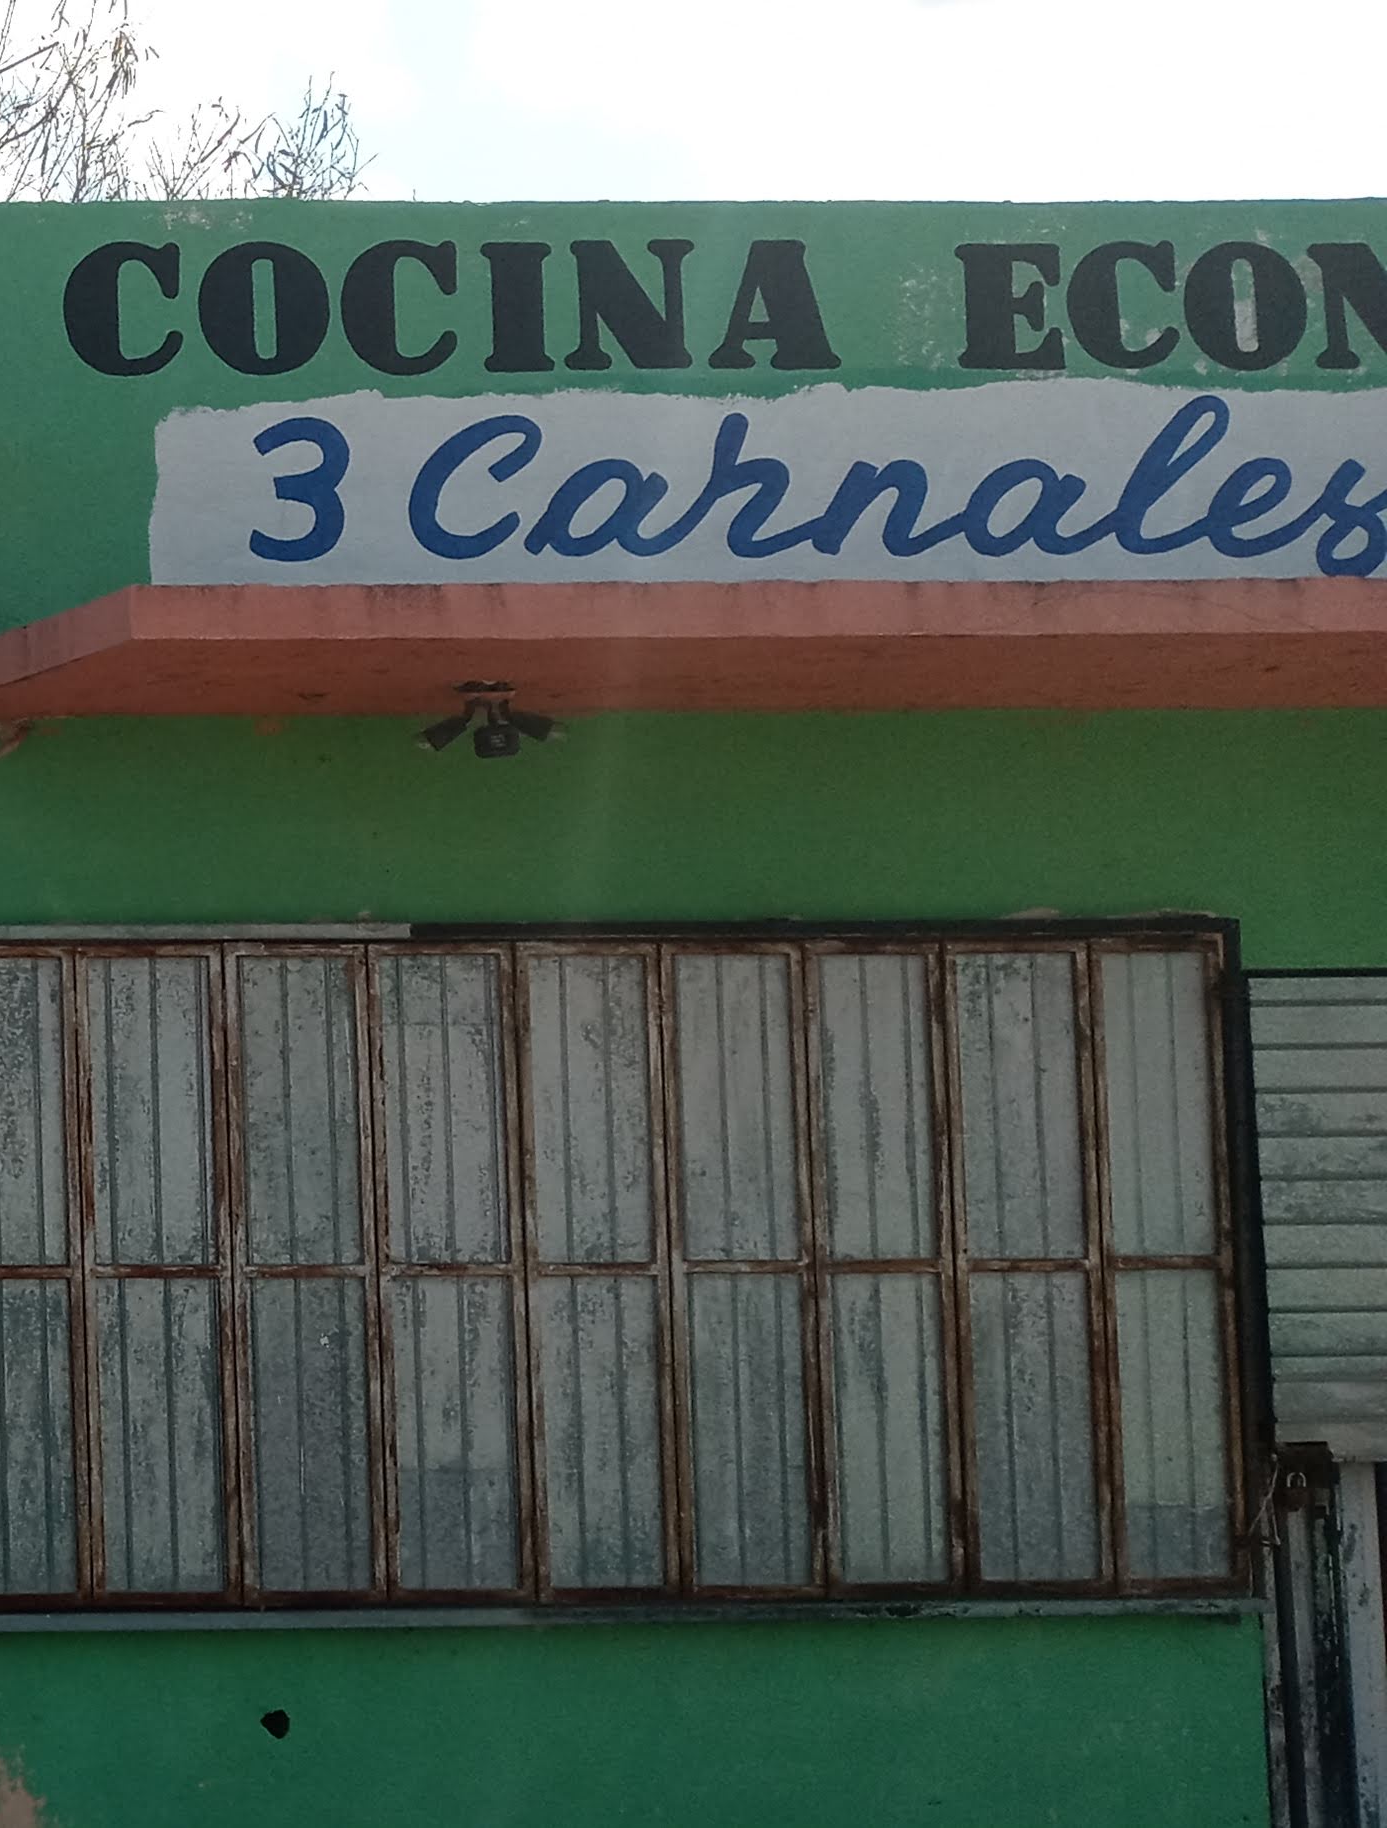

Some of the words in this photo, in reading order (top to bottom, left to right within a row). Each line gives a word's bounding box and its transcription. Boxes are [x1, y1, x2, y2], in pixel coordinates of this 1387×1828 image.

[61, 238, 842, 378] COCINA
[247, 415, 351, 564] 3
[406, 394, 1387, 578] Carnales
